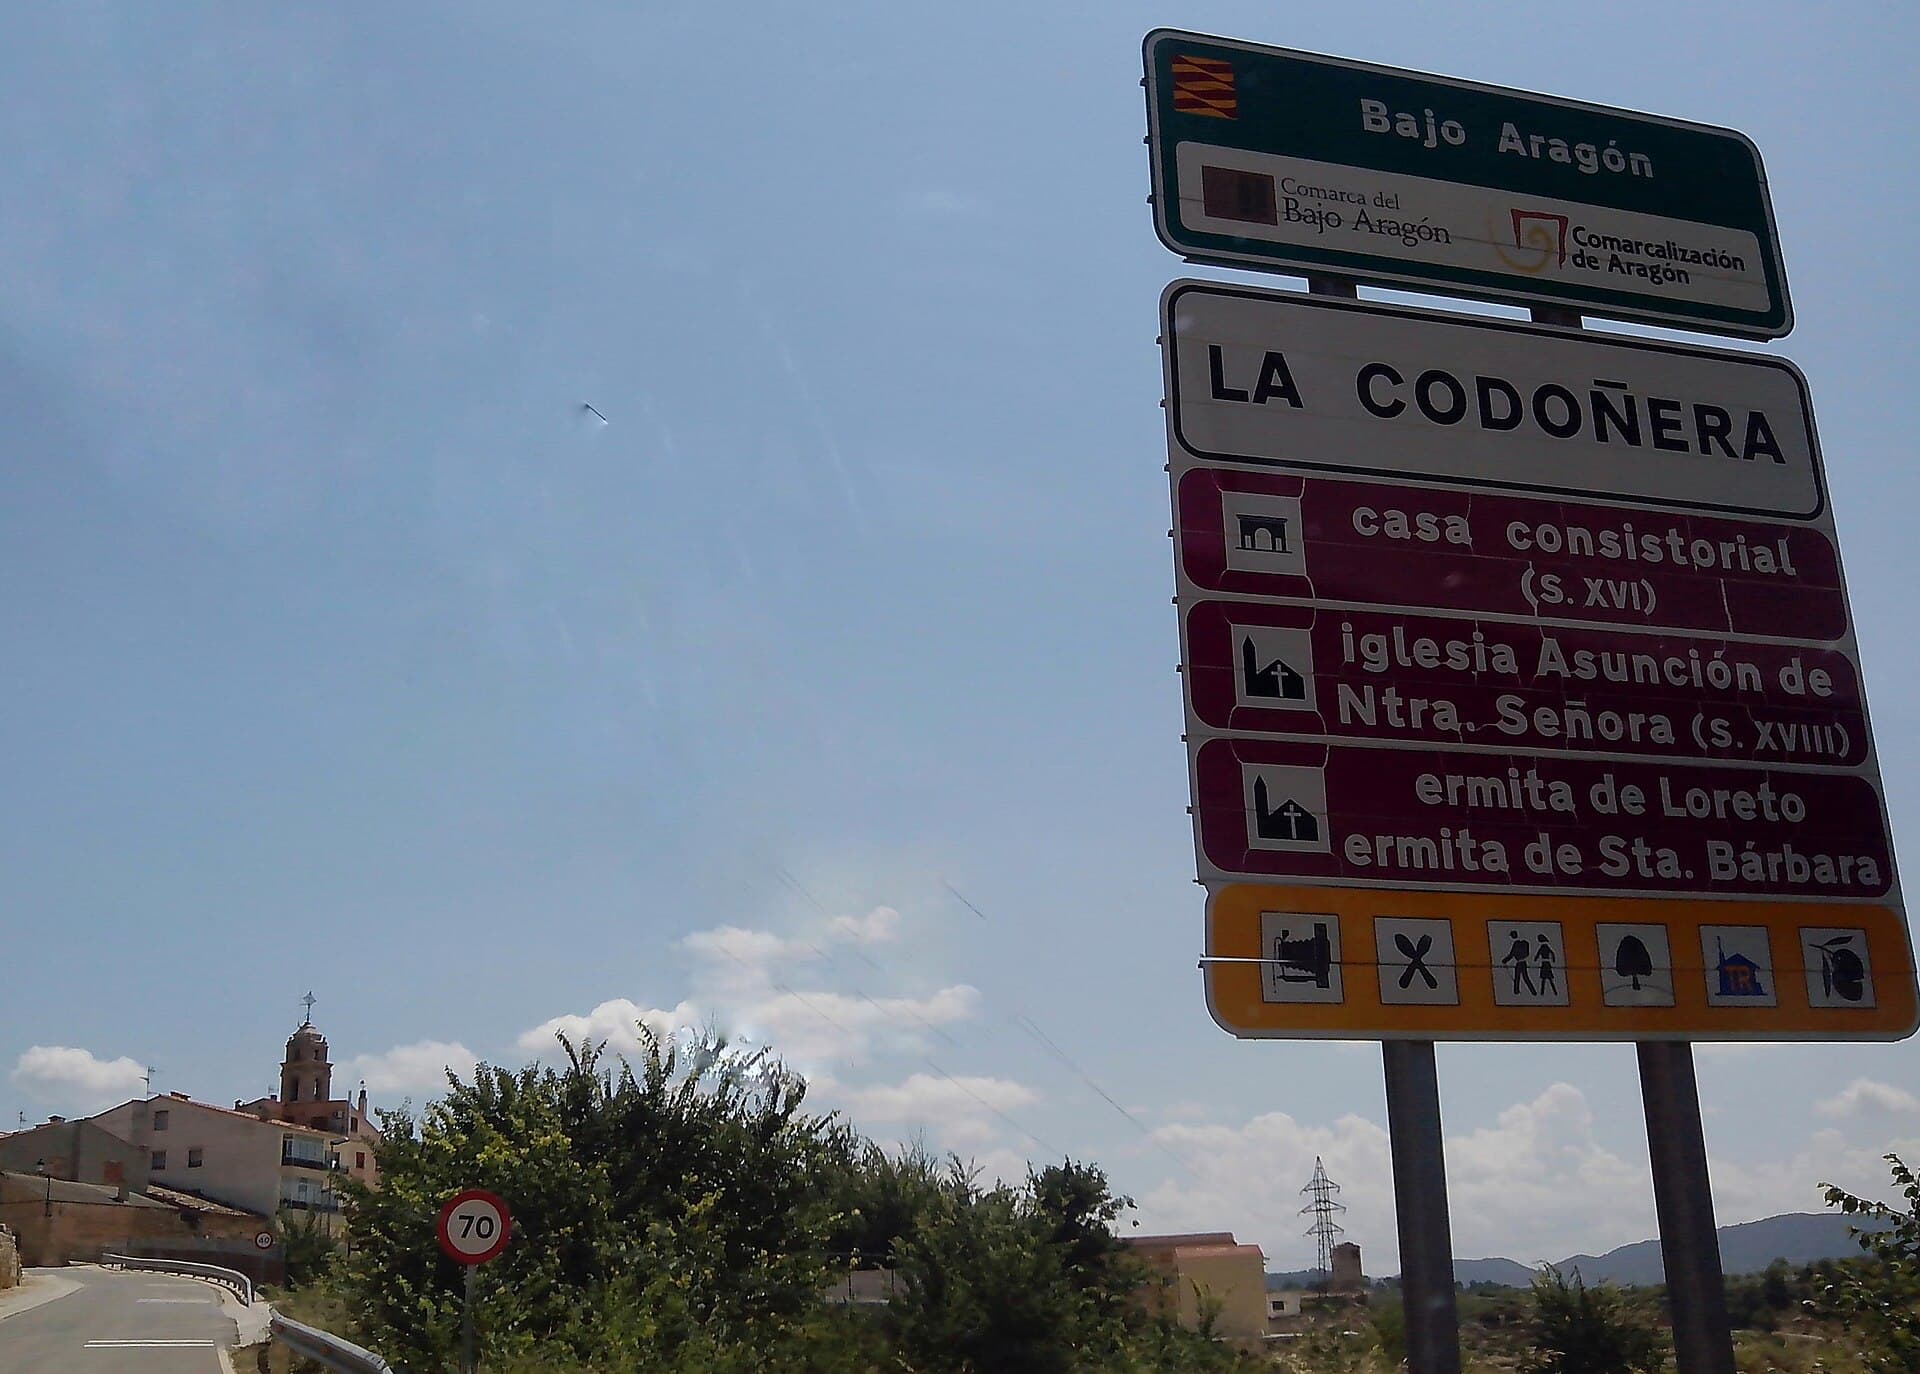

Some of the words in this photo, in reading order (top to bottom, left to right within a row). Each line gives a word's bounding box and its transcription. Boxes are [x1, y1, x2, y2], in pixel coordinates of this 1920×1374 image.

[1361, 98, 1466, 148] Bajo
[1498, 122, 1655, 178] Aragón
[1280, 177, 1367, 206] Comarca
[1373, 192, 1400, 210] del
[1282, 198, 1342, 231] Bajo
[1352, 208, 1453, 247] Aragón
[1571, 225, 1745, 272] Comarcalización
[1571, 250, 1599, 271] de
[1607, 253, 1690, 286] Aragón
[1208, 343, 1304, 409] LA
[1355, 362, 1786, 465] CODOÑERA
[1351, 506, 1472, 546] casa
[1506, 521, 1797, 577] consistorial
[1583, 577, 1656, 616] XVI)
[1341, 623, 1518, 675] iglesia
[1537, 637, 1763, 692] Asunción
[1779, 656, 1833, 697] de
[1338, 685, 1476, 732] Ntra.
[1496, 695, 1674, 745] Señora
[1755, 721, 1850, 758] XVIII)
[1416, 769, 1575, 812] ermita
[1591, 774, 1647, 816] de
[1659, 777, 1806, 822] Loreto
[1344, 827, 1509, 874] ermita
[1525, 831, 1582, 876] de
[1599, 835, 1693, 879] Sta.
[1707, 841, 1880, 888] Bárbara
[458, 1214, 494, 1240] 70
